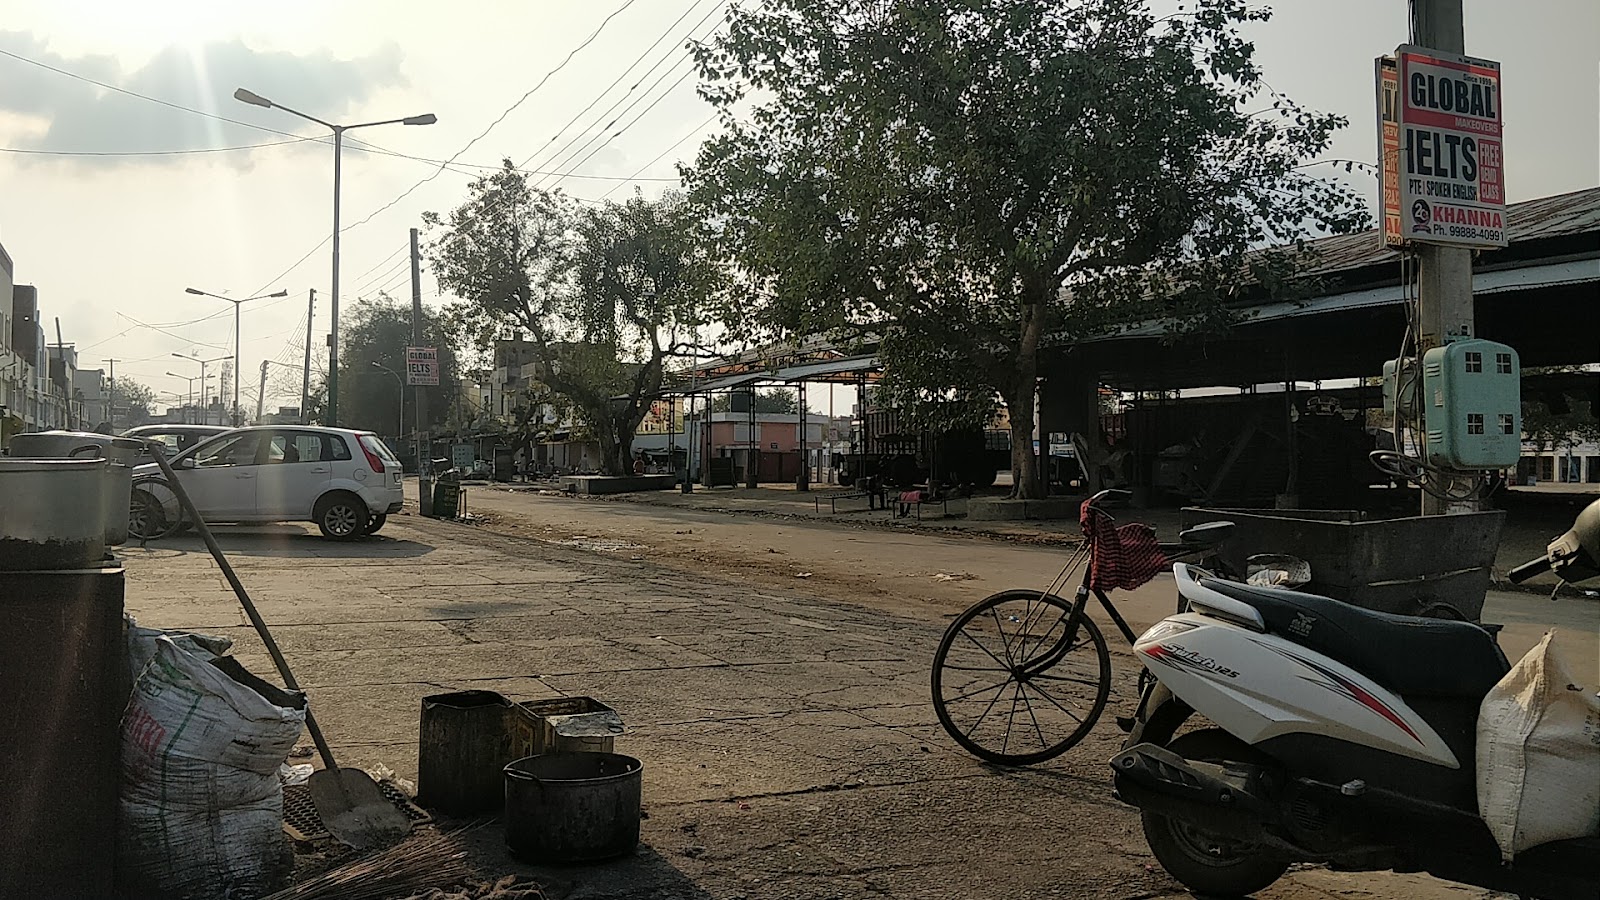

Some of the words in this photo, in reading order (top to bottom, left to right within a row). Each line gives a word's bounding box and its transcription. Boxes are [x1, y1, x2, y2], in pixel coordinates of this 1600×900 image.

[1479, 76, 1492, 86] 1999
[1411, 72, 1496, 119] GLOBAL
[1455, 117, 1498, 133] MAKEOVERS
[1406, 128, 1478, 182] IELTS
[1480, 142, 1500, 168] FREE
[1480, 166, 1497, 184] DEMO
[1409, 179, 1422, 195] PTE
[1426, 181, 1451, 198] SPOKEN
[1452, 184, 1478, 202] ENGLISH
[1481, 183, 1500, 200] CLASS
[1433, 206, 1503, 229] KHANNA
[1433, 224, 1447, 236] Ph.
[1450, 226, 1504, 242] 99888-40991
[410, 352, 436, 360] GLOBAL
[408, 363, 431, 373] IELTS
[1214, 665, 1240, 678] 125
